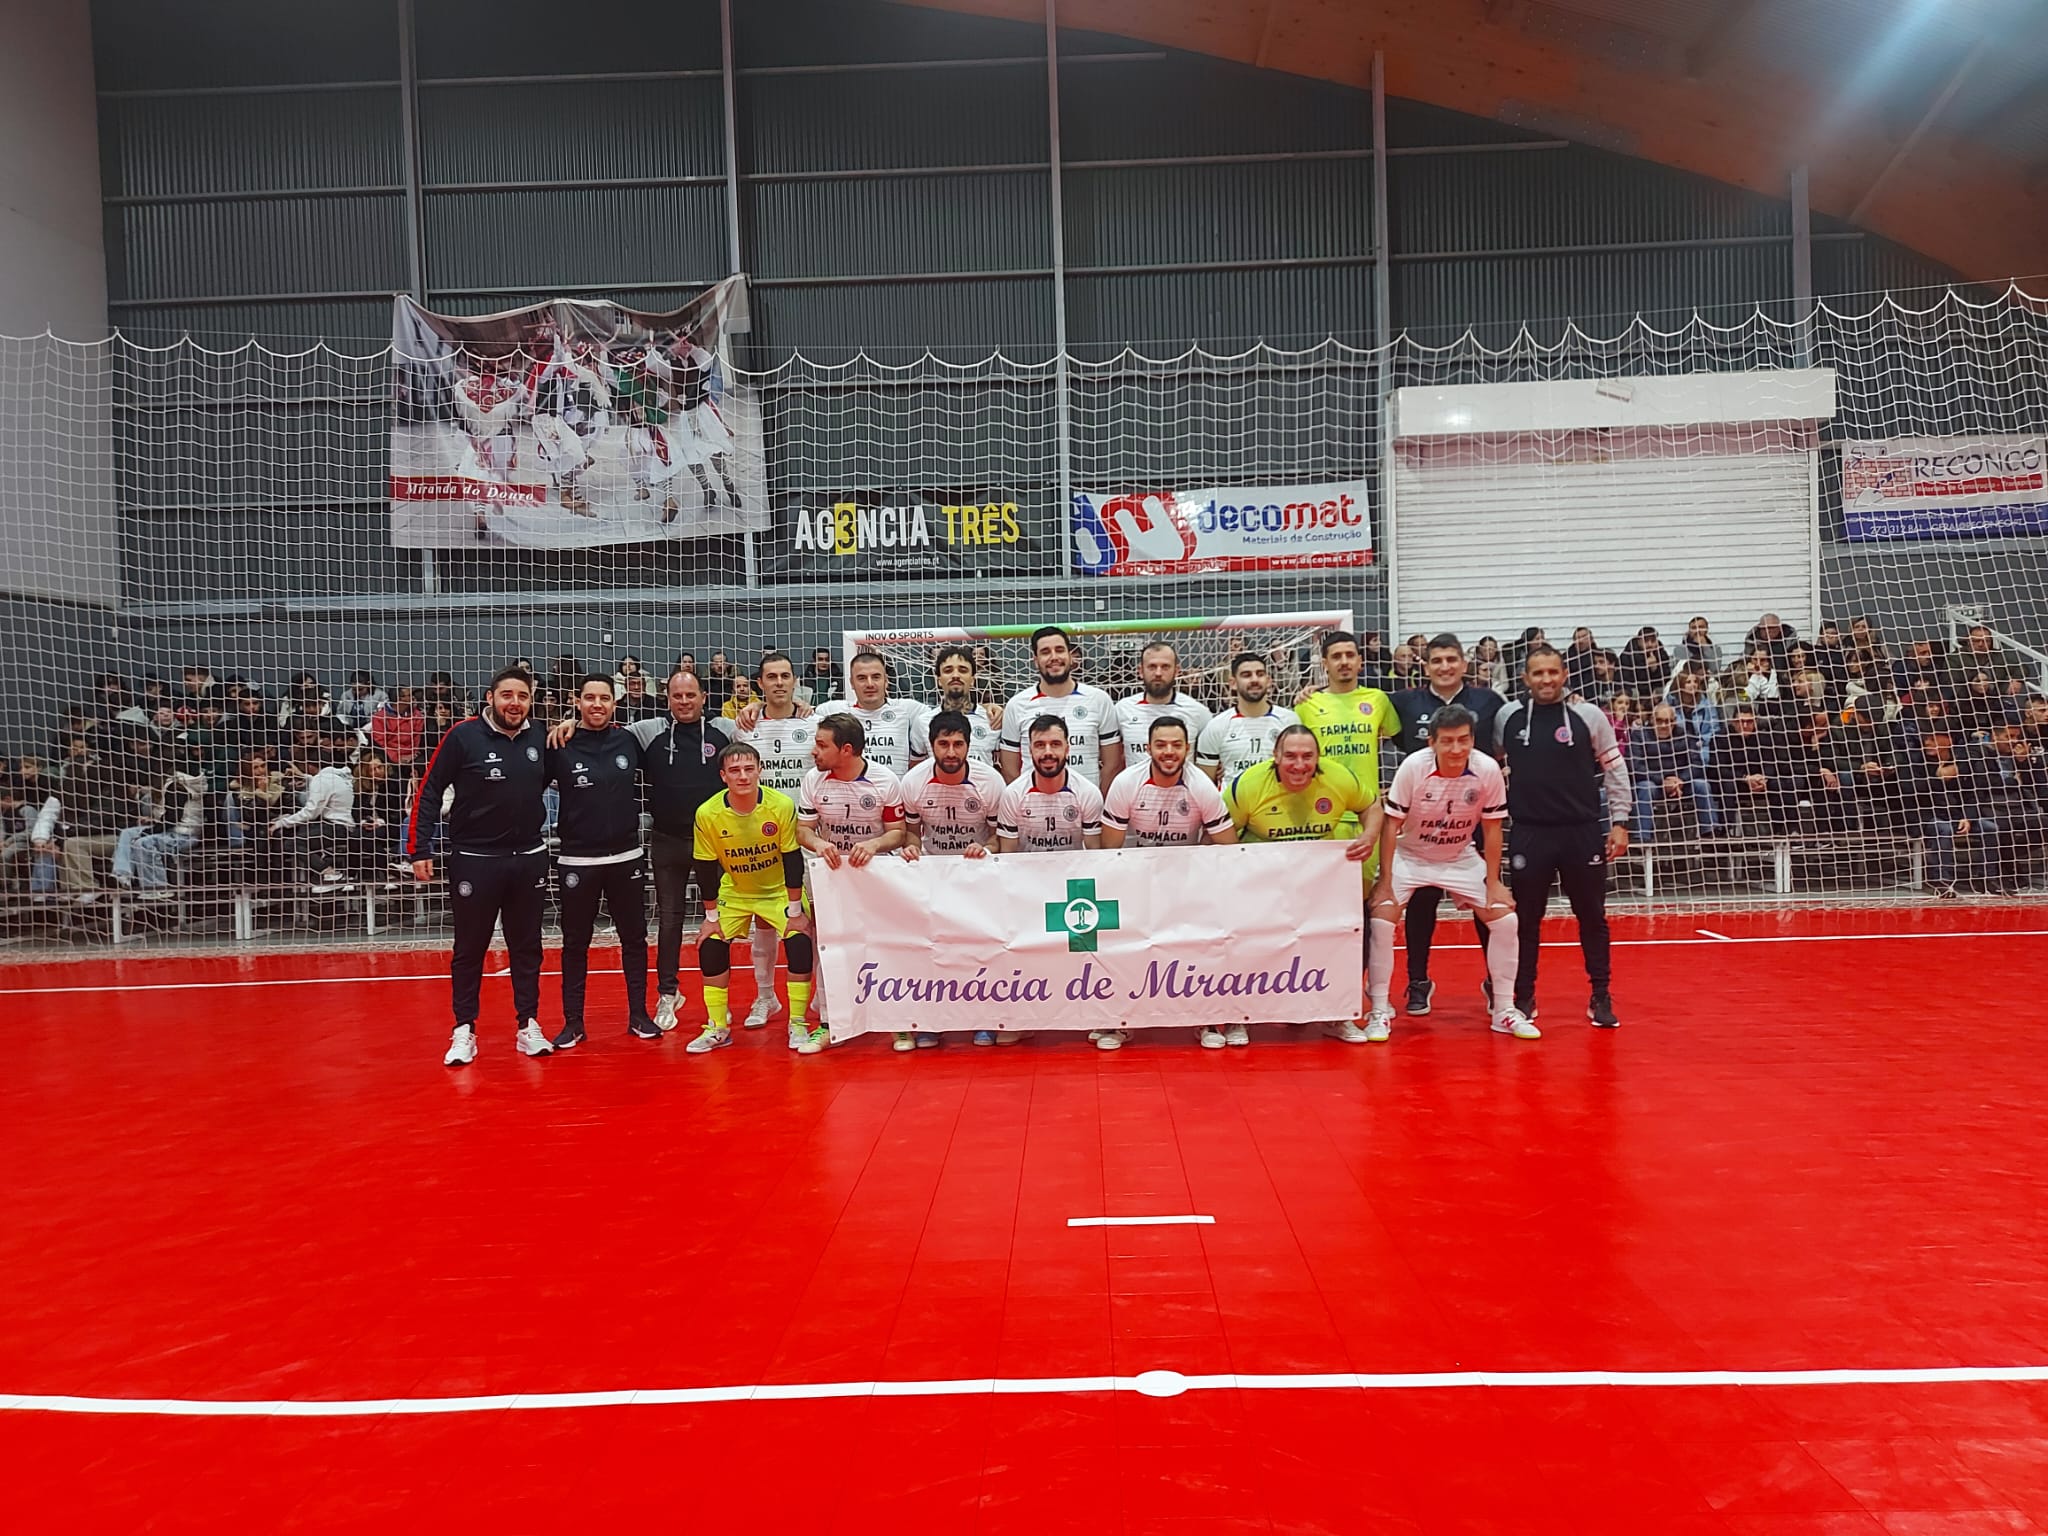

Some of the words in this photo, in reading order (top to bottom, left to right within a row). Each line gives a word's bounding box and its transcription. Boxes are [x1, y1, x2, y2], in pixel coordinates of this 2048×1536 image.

[1915, 449, 2040, 477] RECONCO
[406, 482, 456, 494] Miranda
[462, 484, 480, 496] do
[486, 486, 534, 501] Douro
[1198, 494, 1362, 533] decomat
[942, 502, 1020, 545] TRÊS
[1243, 533, 1287, 545] Materiais
[1291, 533, 1302, 543] de
[1306, 530, 1362, 543] Construção
[865, 633, 886, 641] INOV
[898, 631, 934, 640] SPORTS
[865, 720, 872, 732] 3
[1320, 722, 1373, 736] FARMÁCIA
[774, 739, 782, 753] 9
[1249, 738, 1261, 753] 17
[1324, 743, 1371, 757] MIRANDA
[760, 757, 803, 770] ARMÁCIA
[845, 804, 851, 819] 7
[894, 806, 904, 818] C
[945, 807, 956, 820] 11
[1158, 811, 1169, 826] 10
[1045, 817, 1056, 831] 19
[1268, 823, 1332, 838] FARMÁCIA
[1420, 818, 1473, 830] FARMÁCIA
[1419, 833, 1467, 845] MIRANDA
[724, 842, 778, 858] FARMÁCIA
[730, 855, 779, 873] MIRANDA
[855, 962, 1053, 1004] Farmácia
[1065, 963, 1115, 1000] de
[1128, 956, 1330, 999] Miranda
